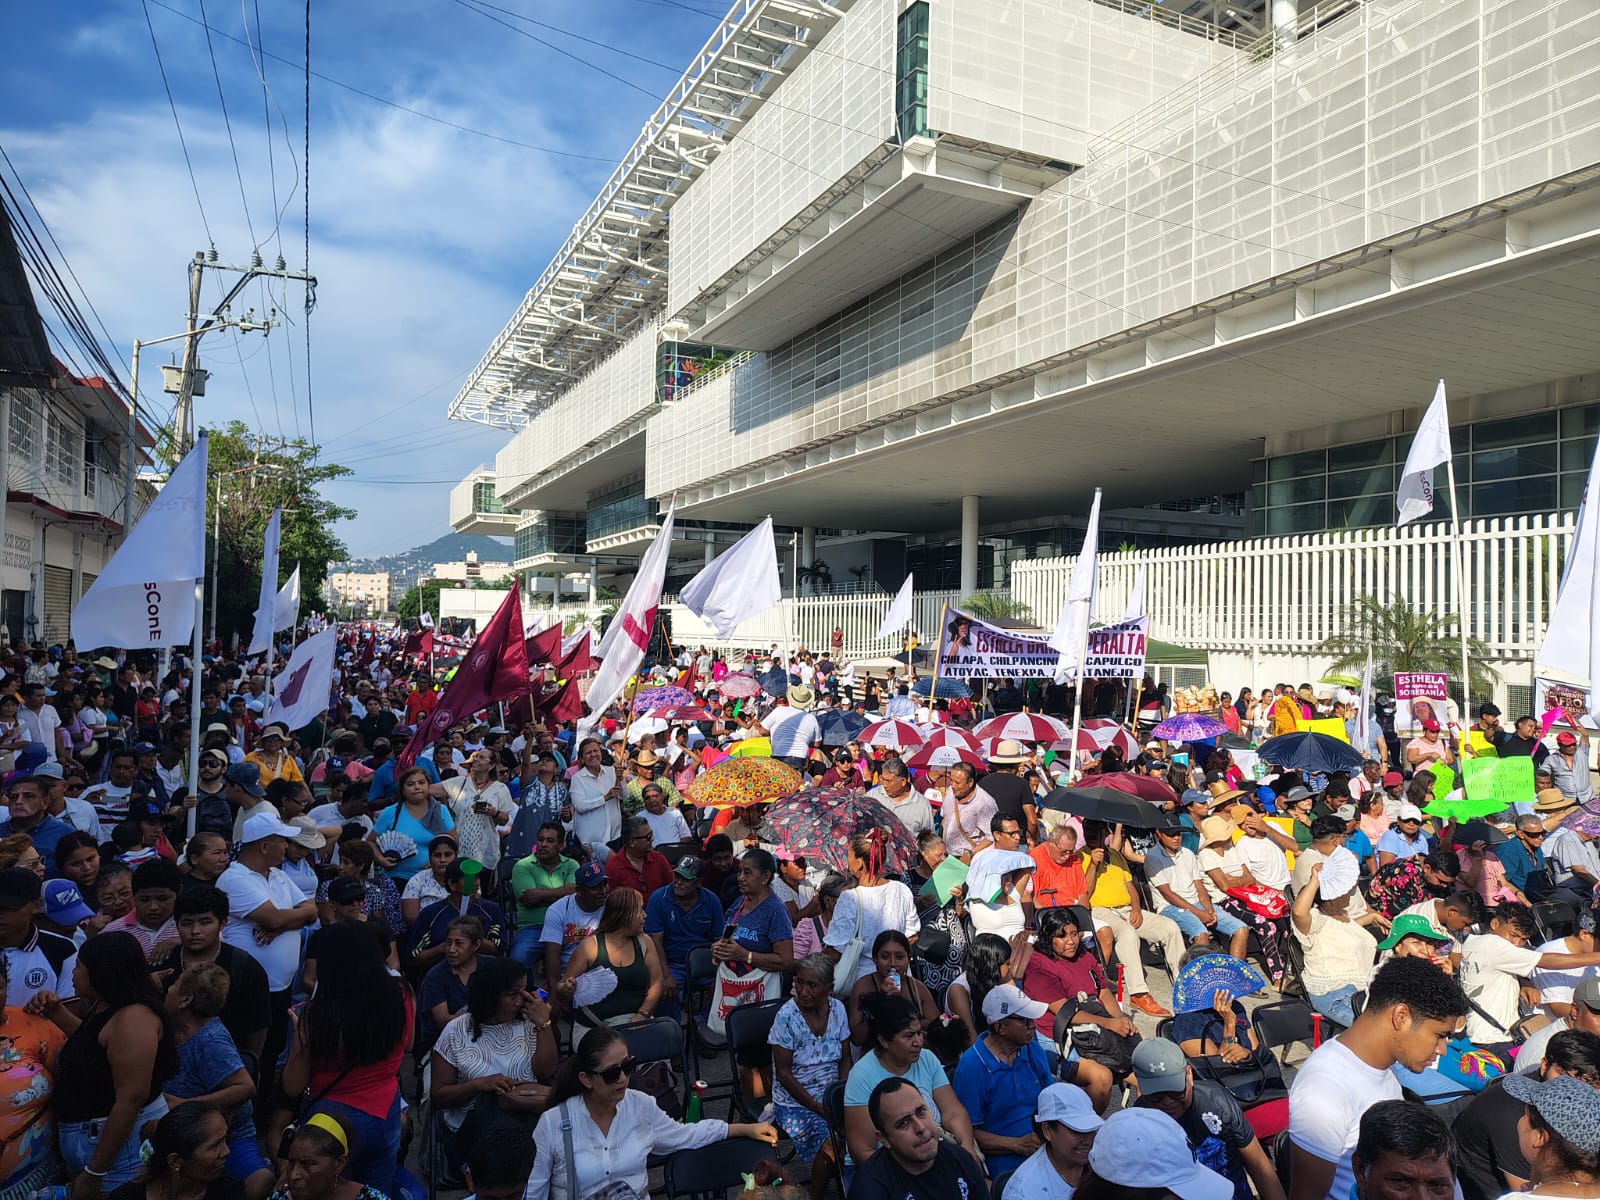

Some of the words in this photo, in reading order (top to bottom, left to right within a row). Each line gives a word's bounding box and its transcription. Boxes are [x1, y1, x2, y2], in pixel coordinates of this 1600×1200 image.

[989, 656, 1059, 666] CHILPANCIN
[1085, 657, 1142, 666] CAPULCO
[1398, 675, 1445, 685] ESTHELA
